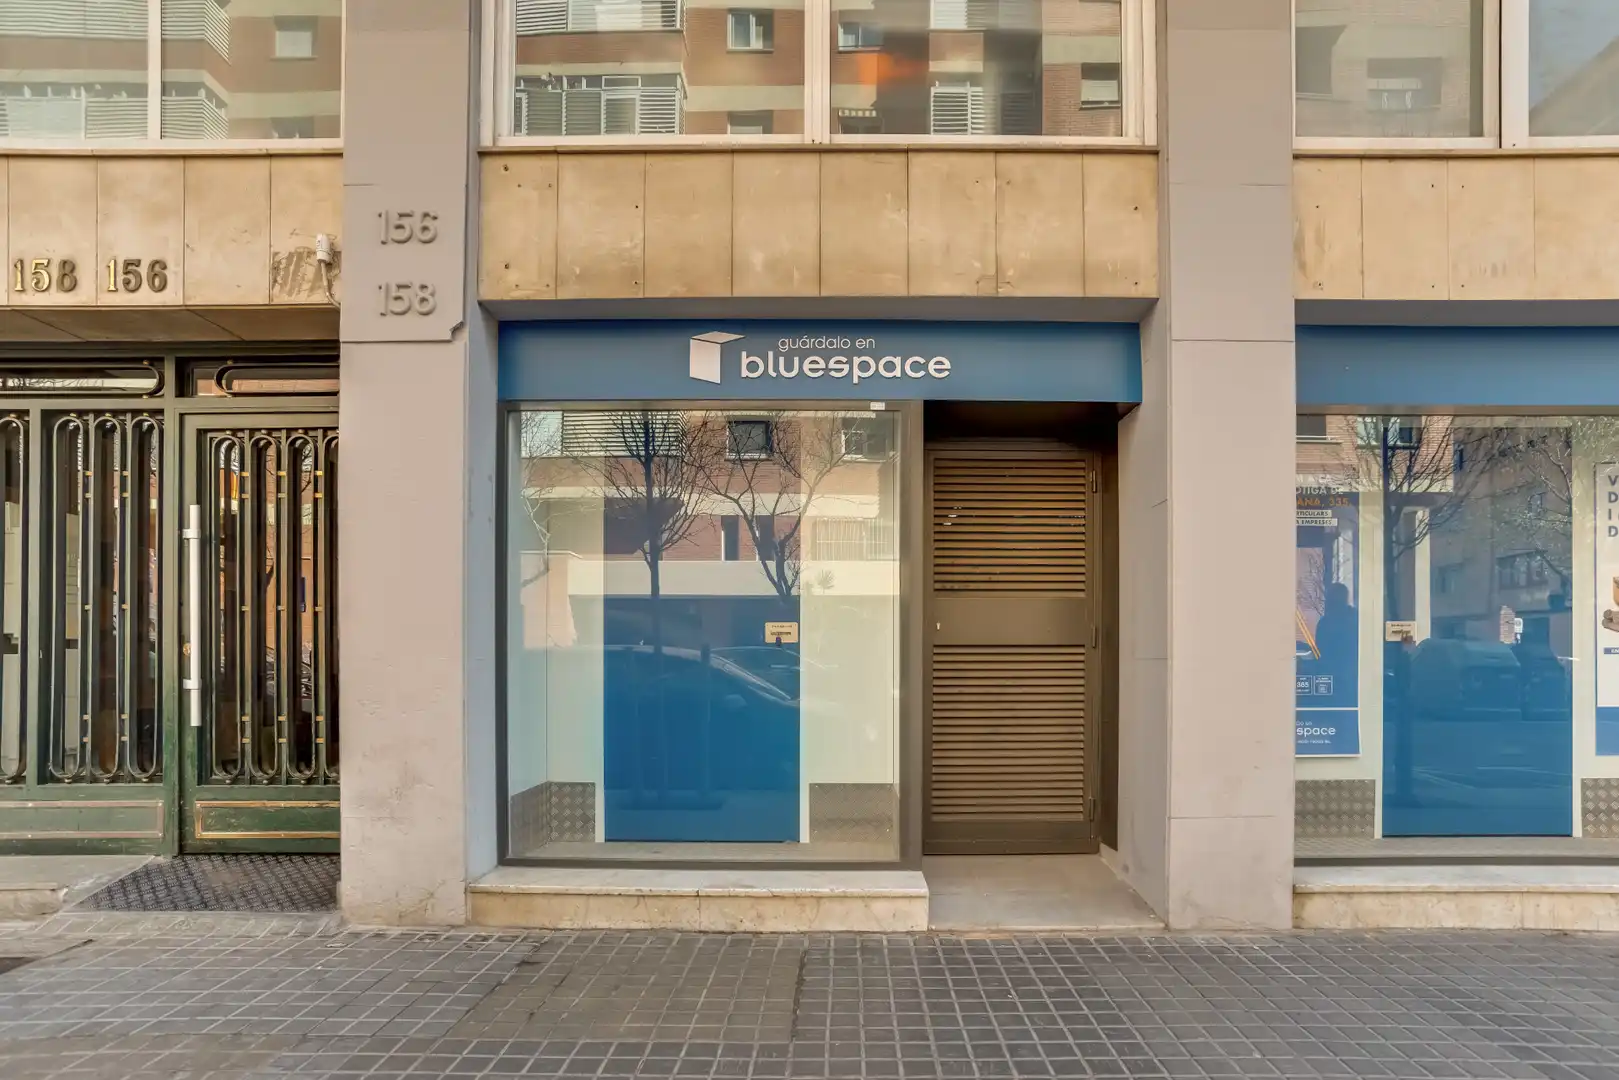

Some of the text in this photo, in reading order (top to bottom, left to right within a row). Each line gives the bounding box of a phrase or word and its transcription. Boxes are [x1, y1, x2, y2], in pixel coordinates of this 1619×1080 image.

[378, 210, 438, 245] 156
[14, 258, 168, 292] 158 156
[378, 282, 437, 317] 158
[778, 335, 875, 352] guárdalo en
[740, 351, 952, 385] bluespace
